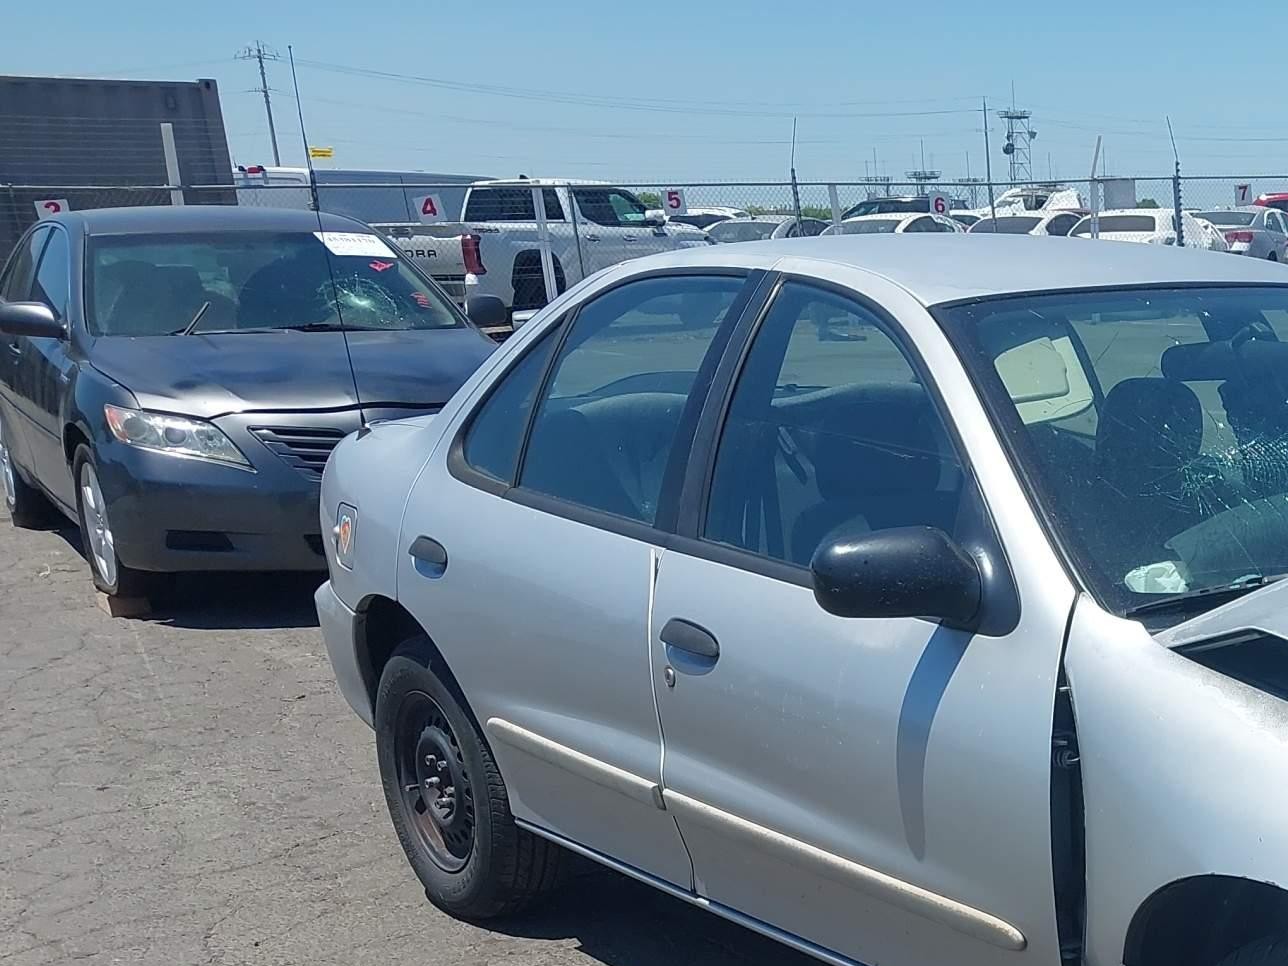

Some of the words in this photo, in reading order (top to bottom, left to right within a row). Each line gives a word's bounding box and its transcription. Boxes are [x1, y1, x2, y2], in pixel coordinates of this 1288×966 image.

[667, 191, 681, 209] 5
[1238, 185, 1248, 201] 7
[422, 197, 438, 217] 4
[934, 196, 946, 214] 6
